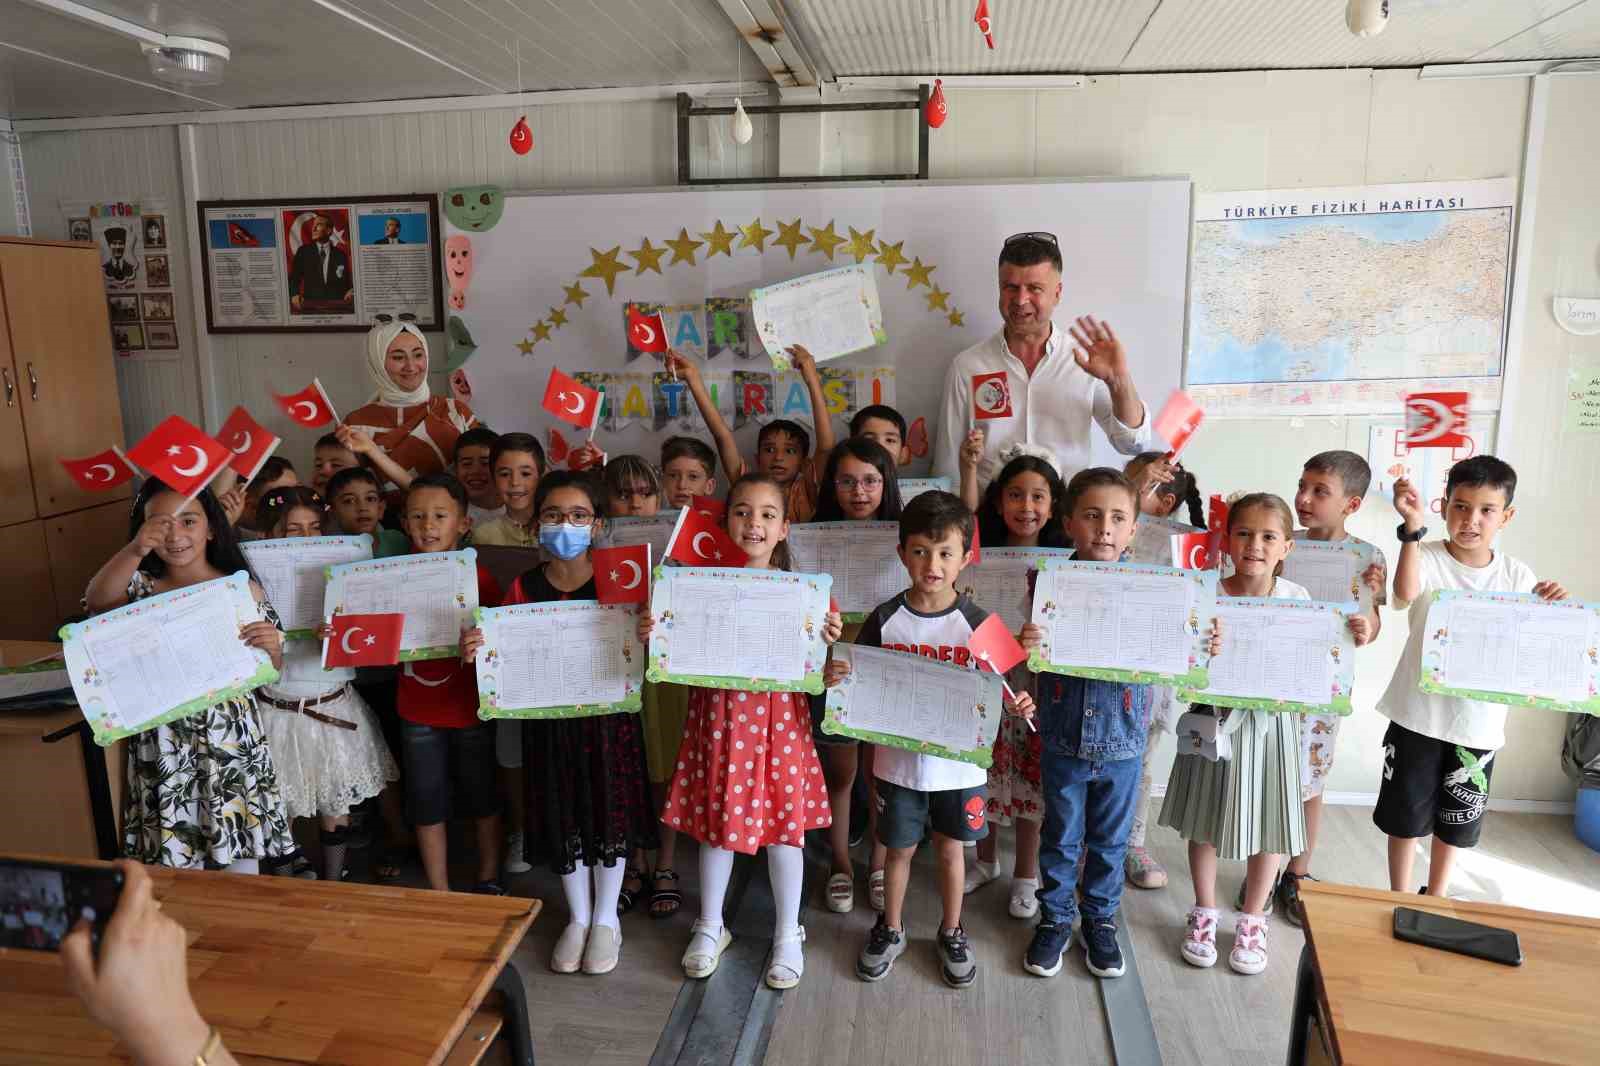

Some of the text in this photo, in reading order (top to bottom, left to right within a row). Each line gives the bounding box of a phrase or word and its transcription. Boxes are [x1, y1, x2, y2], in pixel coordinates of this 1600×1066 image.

[1224, 196, 1465, 218] TÜRKİYE FİZİKİ HARİTASI
[1440, 811, 1465, 822] HITE
